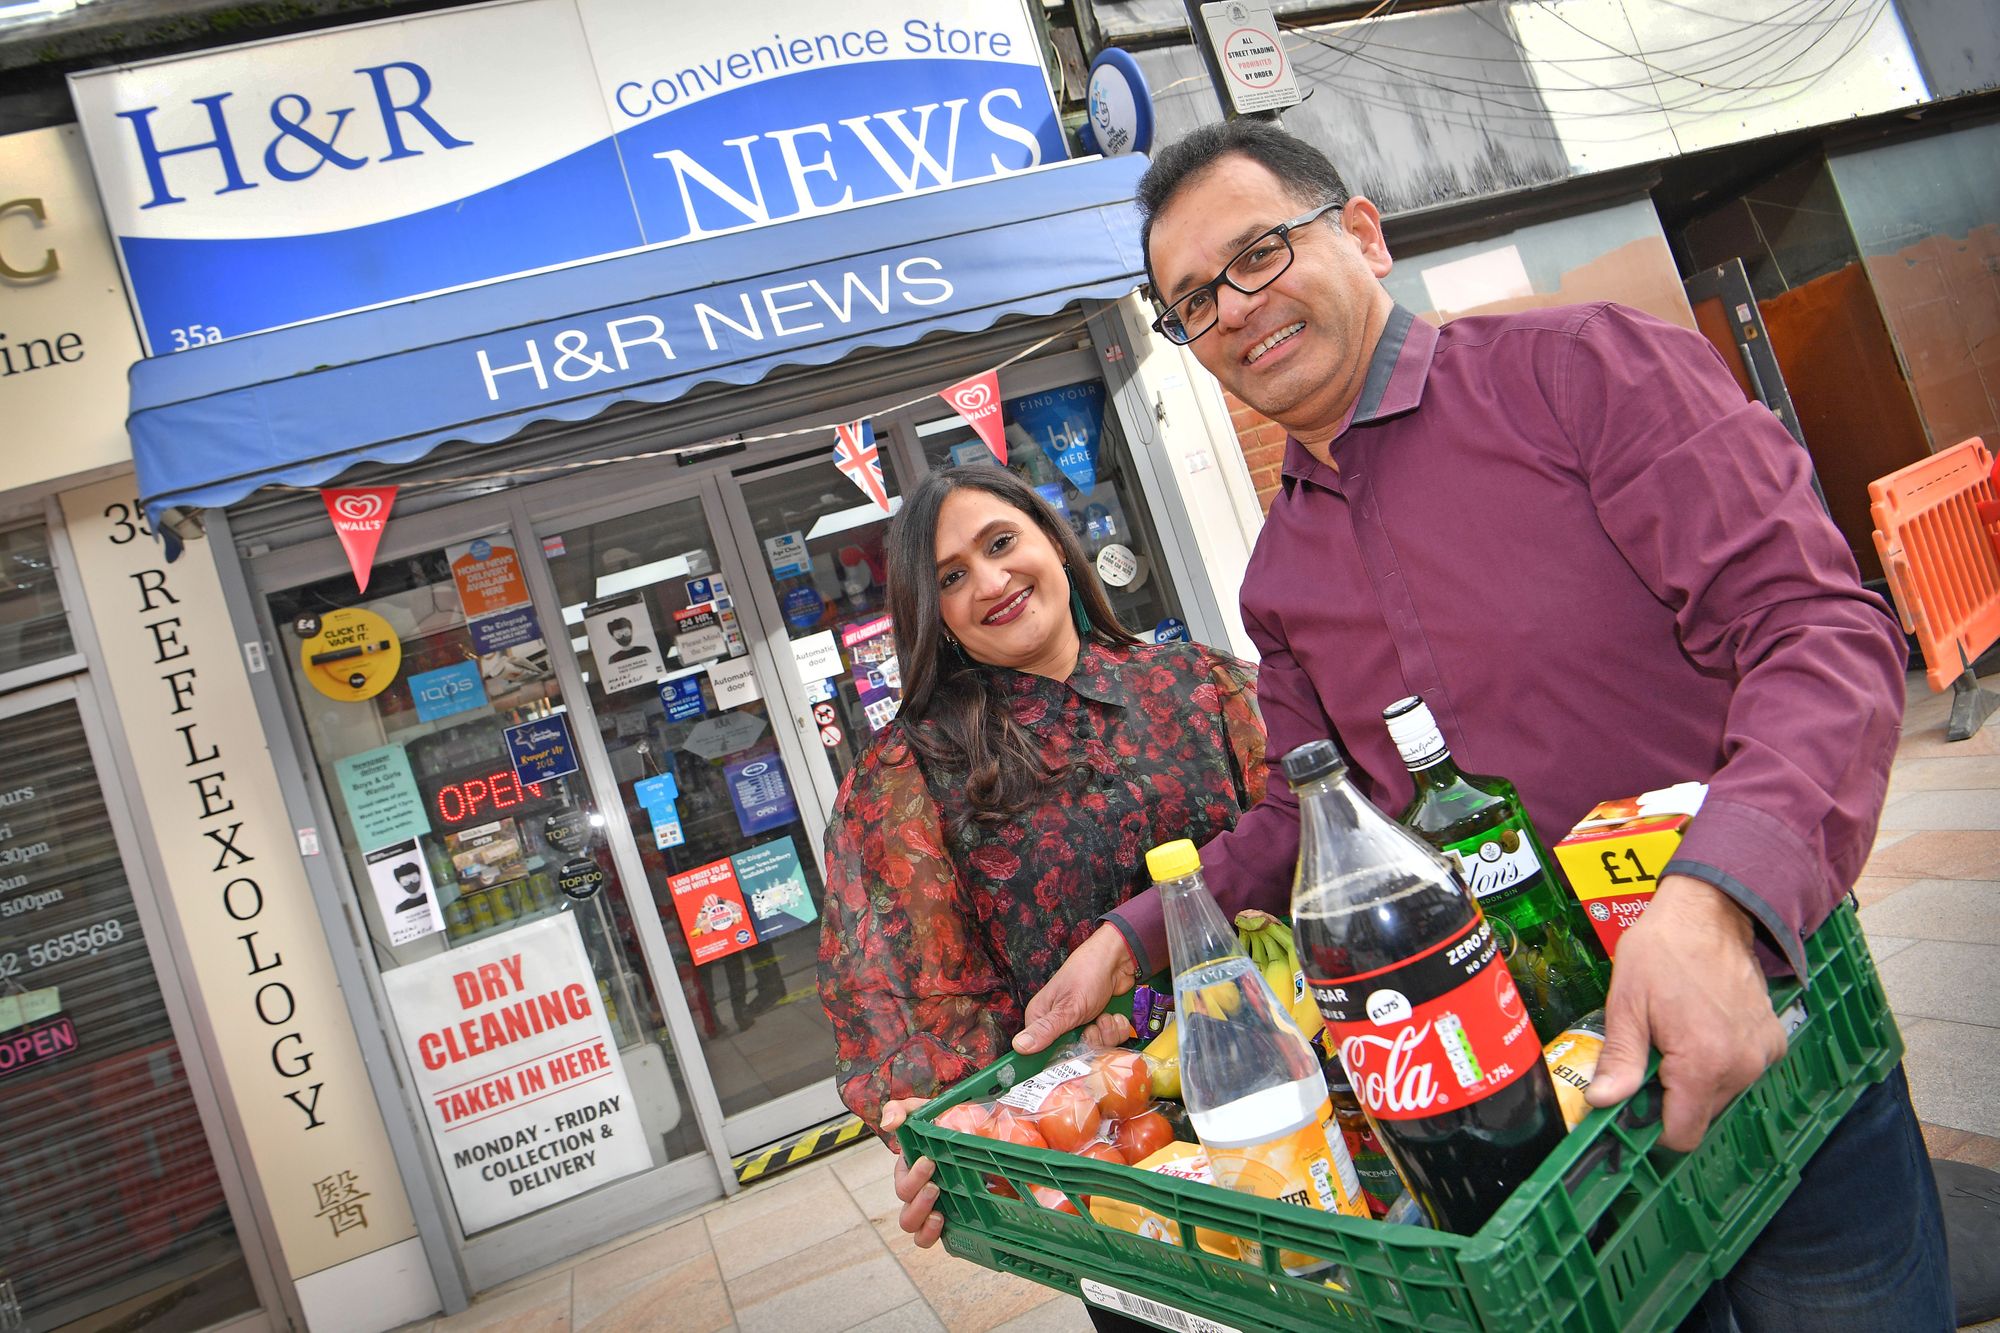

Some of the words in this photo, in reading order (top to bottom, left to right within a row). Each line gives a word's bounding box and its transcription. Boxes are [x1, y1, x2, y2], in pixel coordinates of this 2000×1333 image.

[1242, 37, 1253, 45] ALL
[1227, 49, 1249, 59] STREET
[1250, 45, 1275, 56] TRADING
[615, 23, 889, 119] Convenience
[903, 19, 1012, 58] Store
[1238, 58, 1272, 69] PROHIBITED
[1245, 72, 1253, 81] BY
[1254, 70, 1274, 79] ORDER
[115, 60, 474, 210] H&R
[653, 87, 1041, 240] NEWS
[476, 314, 677, 401] H&R
[694, 256, 955, 351] NEWS
[170, 325, 224, 352] 35a
[1019, 395, 1053, 412] FIND
[1059, 385, 1097, 401] YOUR
[965, 403, 997, 421] WALL'S
[1047, 421, 1088, 451] blu
[1060, 450, 1092, 467] HERE
[338, 519, 382, 532] WALL'S
[297, 619, 316, 630] £4
[324, 626, 354, 639] CLICK
[357, 624, 369, 632] IT.
[680, 617, 693, 628] 24
[328, 635, 355, 647] VAPE
[357, 633, 369, 641] IT.
[1157, 625, 1183, 642] OREO
[795, 645, 834, 661] Automatic
[808, 657, 827, 667] door
[714, 670, 755, 686] Automatic
[727, 682, 746, 693] door
[421, 678, 474, 702] IQOS
[352, 780, 373, 791] Boys
[382, 771, 402, 781] Girls
[364, 782, 396, 796] Wanted
[757, 805, 778, 817] OPEN
[472, 836, 493, 847] OPEN
[546, 827, 570, 841] TOP
[129, 568, 327, 1131] REFLEXOLOGY
[1600, 848, 1658, 885] £1
[560, 876, 582, 889] TOP
[582, 871, 603, 883] 100
[1502, 888, 1519, 900] GIN
[28, 919, 124, 968] 565568
[1446, 933, 1482, 967] ZERO
[1465, 961, 1481, 975] NO
[452, 953, 526, 1010] DRY
[1371, 1001, 1400, 1020] £1.75
[418, 982, 593, 1072] CLEANING
[0, 1022, 74, 1070] OPEN
[1338, 1019, 1440, 1110] Cola
[1485, 1062, 1514, 1085] 1.75L
[435, 1075, 516, 1125] TAKEN
[518, 1064, 546, 1097] IN
[547, 1042, 611, 1085] HERE
[453, 1124, 538, 1170] MONDAY
[555, 1095, 622, 1134] FRIDAY
[481, 1128, 595, 1182] COLLECTION
[600, 1123, 614, 1139] &
[508, 1150, 597, 1197] DELIVERY
[311, 1169, 373, 1240] 醫
